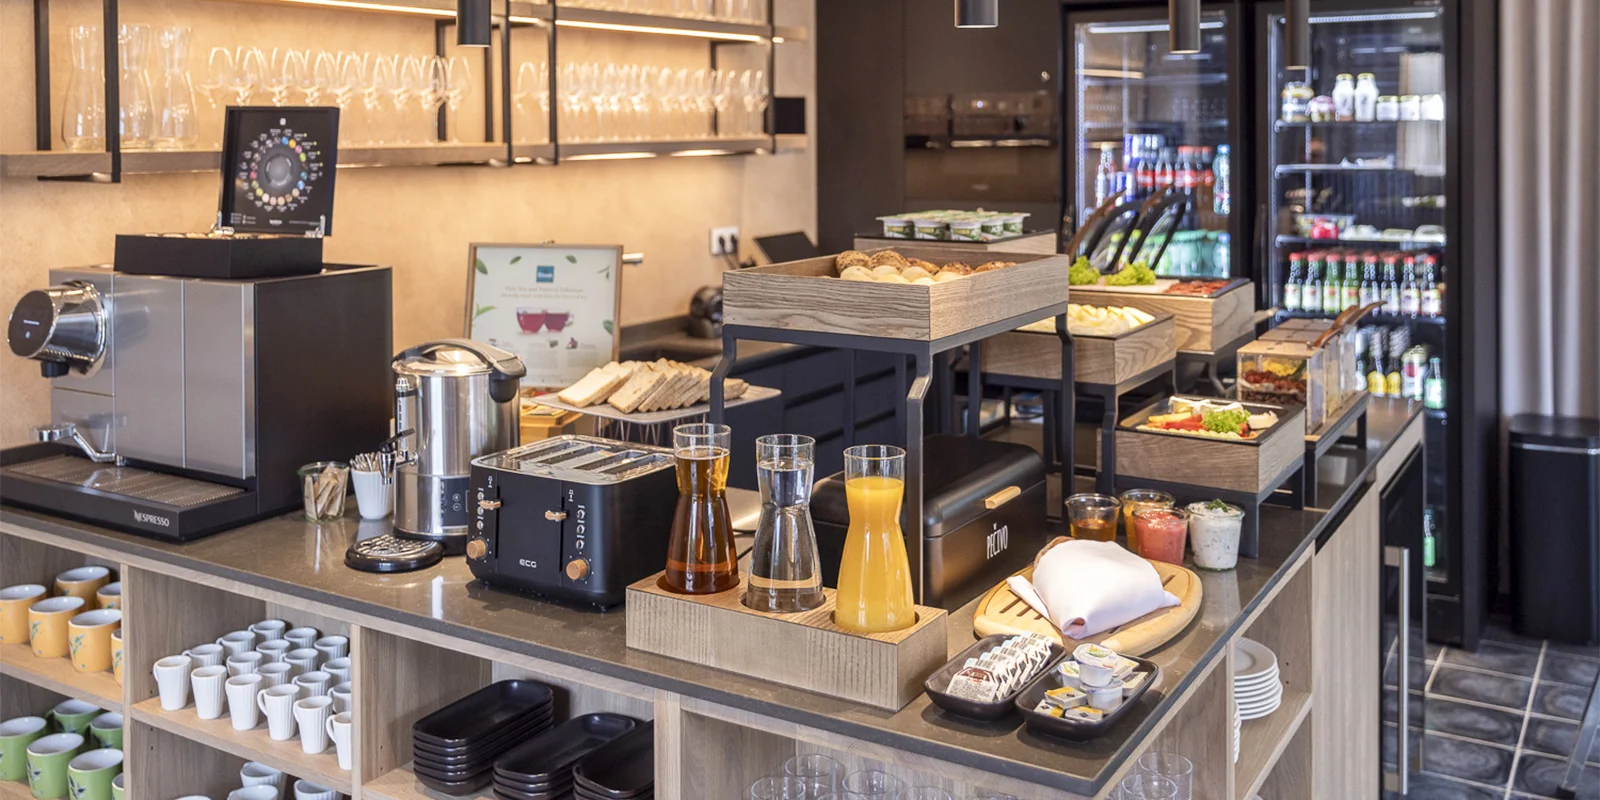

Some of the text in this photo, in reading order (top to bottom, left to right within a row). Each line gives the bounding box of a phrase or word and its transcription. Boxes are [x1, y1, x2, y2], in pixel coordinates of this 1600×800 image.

[133, 509, 170, 527] NESPRESSO
[986, 522, 1009, 560] PEČIVO
[519, 558, 537, 569] ECG
